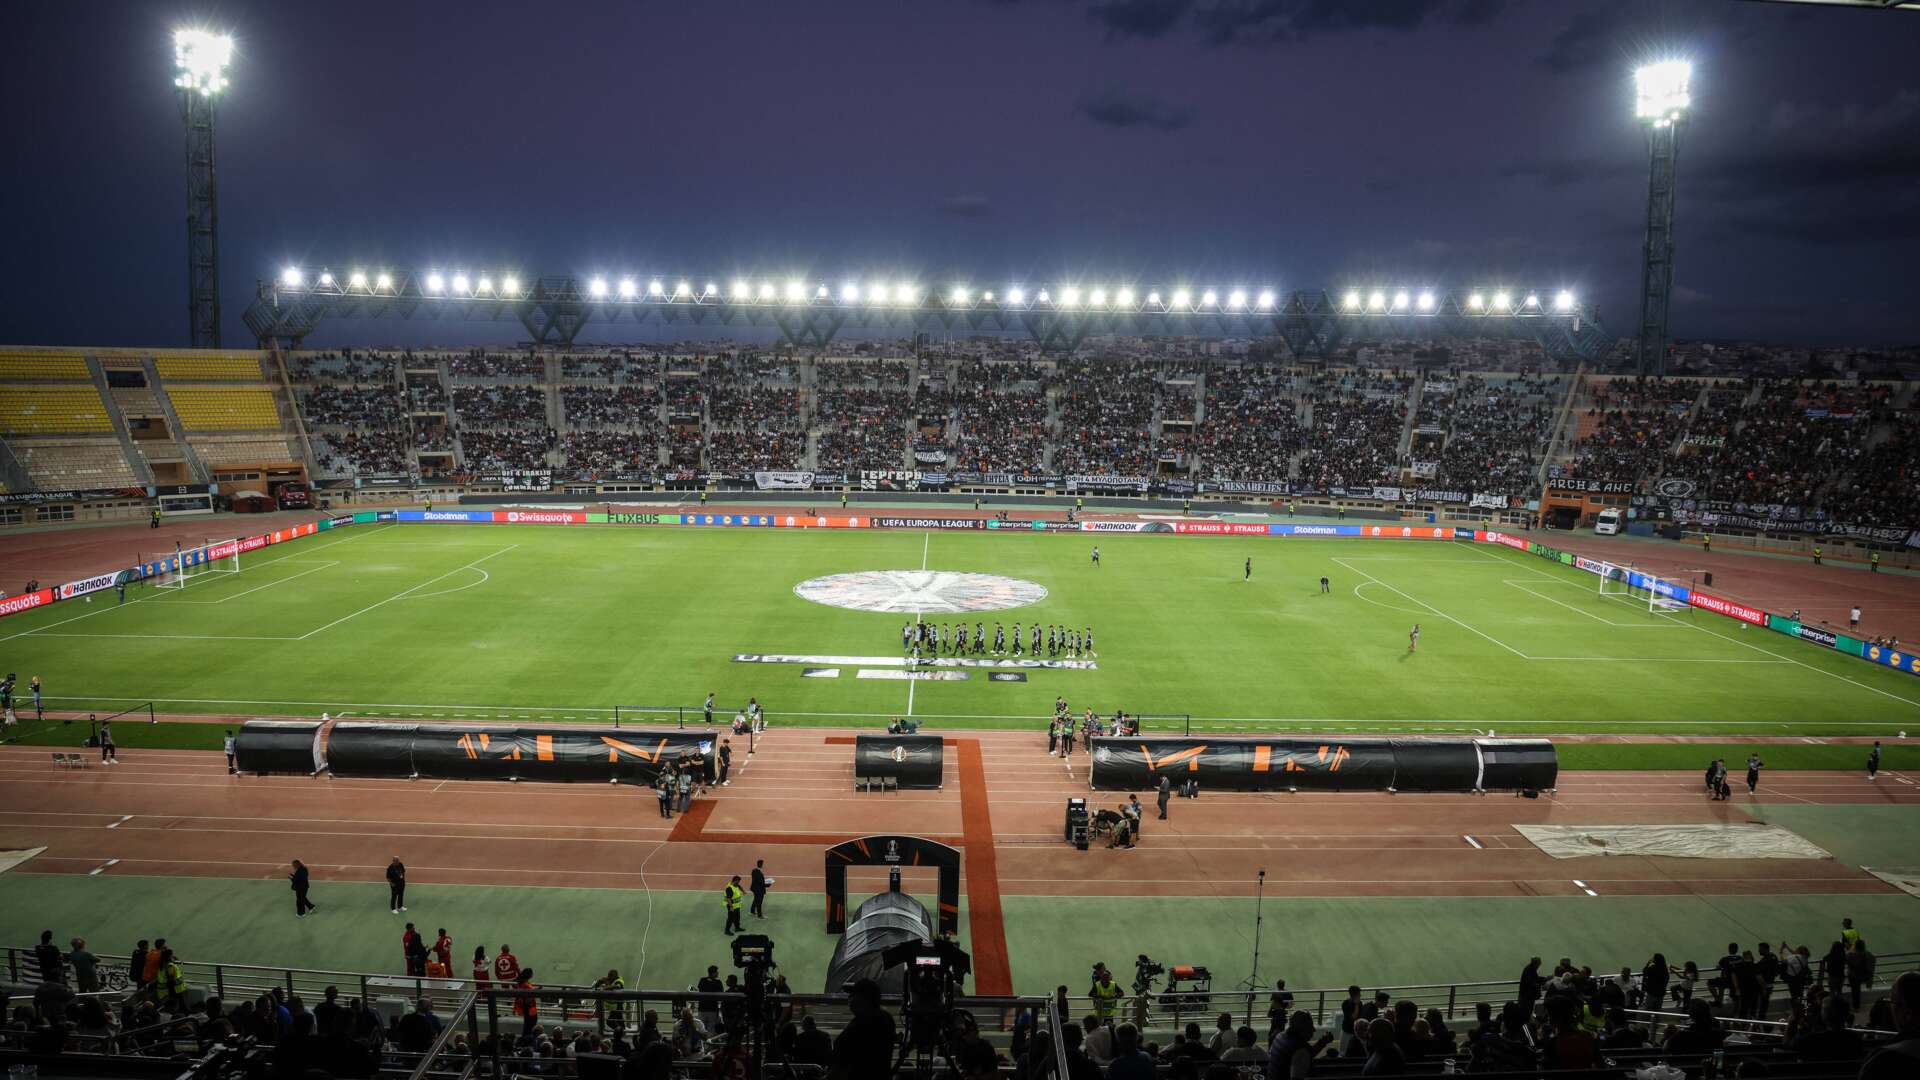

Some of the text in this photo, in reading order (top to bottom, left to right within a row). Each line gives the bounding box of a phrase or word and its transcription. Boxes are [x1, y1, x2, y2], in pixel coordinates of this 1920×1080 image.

[520, 512, 573, 523] Swissquote
[882, 519, 974, 528] UEFA EUROPA LEAGUE
[992, 520, 1079, 530] enterprise enterprise
[1189, 524, 1265, 533] STRAUSS STRAUSS
[1696, 595, 1761, 622] STRAUSS STRAUSS
[1795, 625, 1836, 643] enterprise
